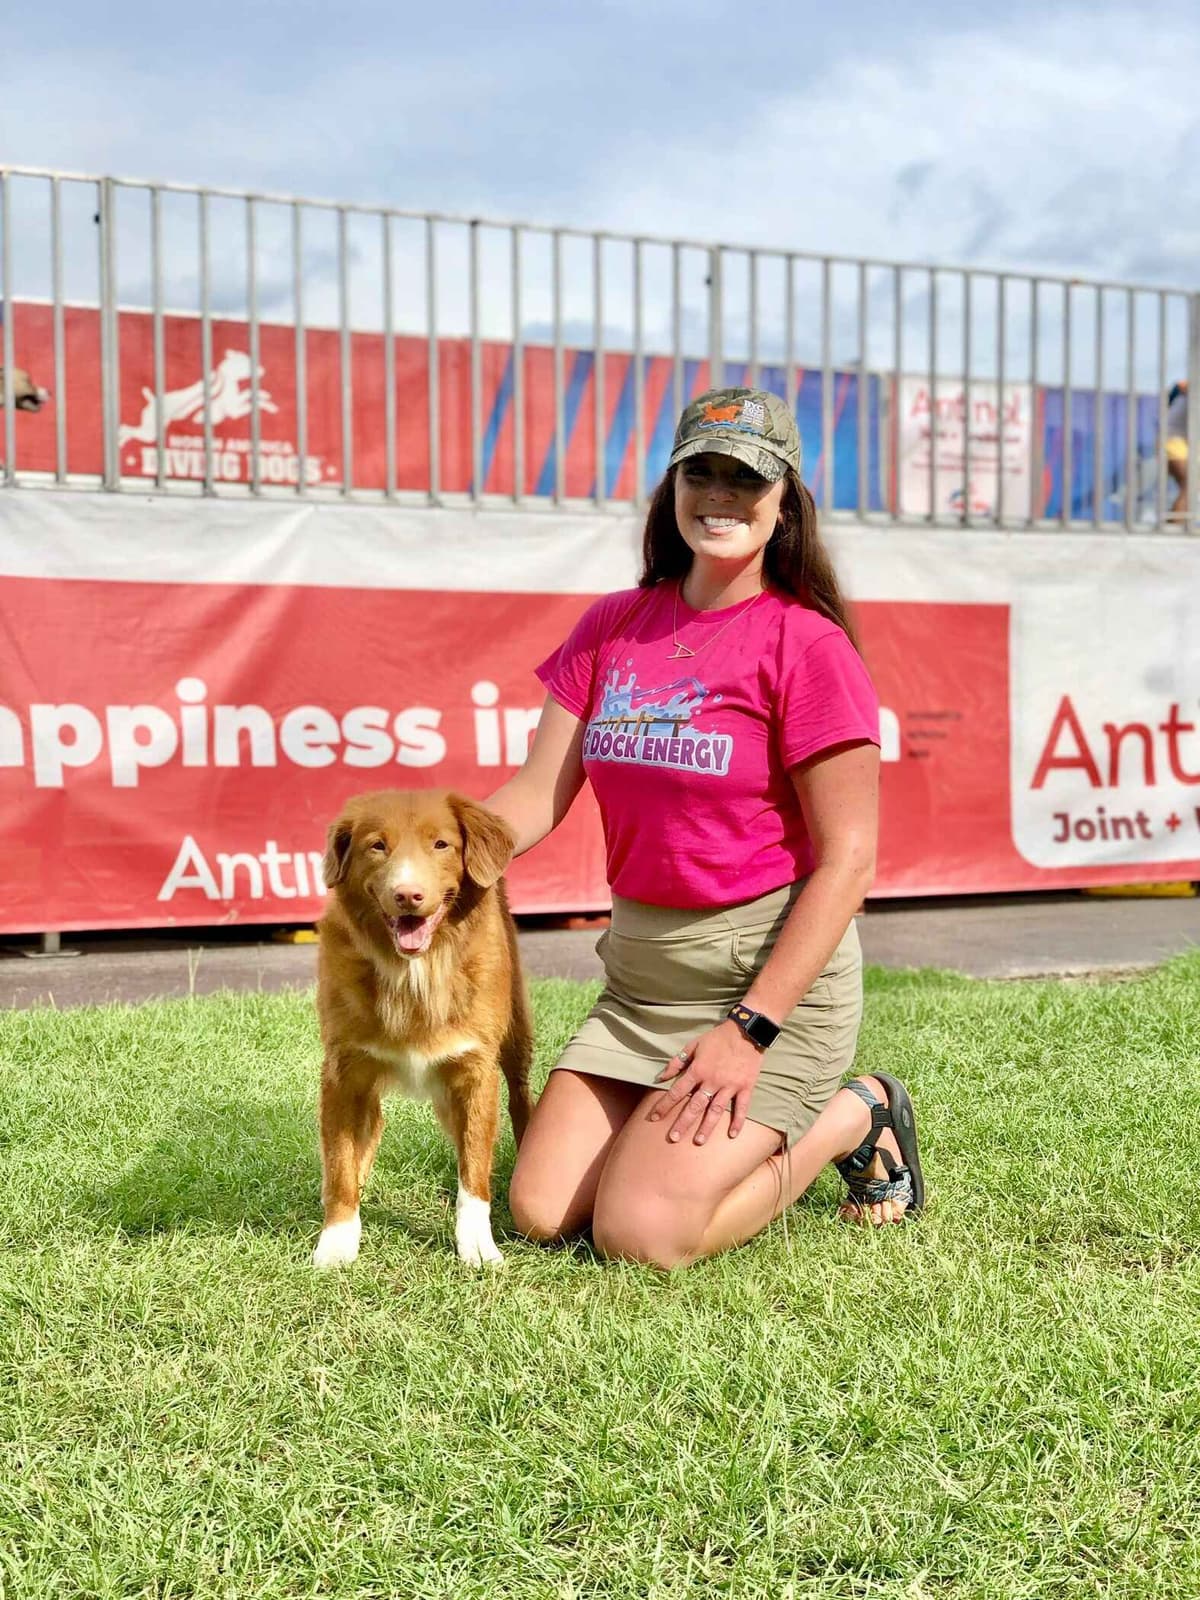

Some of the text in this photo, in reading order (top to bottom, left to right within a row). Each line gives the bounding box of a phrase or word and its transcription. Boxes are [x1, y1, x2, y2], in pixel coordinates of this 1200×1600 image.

[590, 730, 637, 758] DOCK
[641, 737, 727, 771] ENERGY
[1052, 805, 1153, 843] Joint
